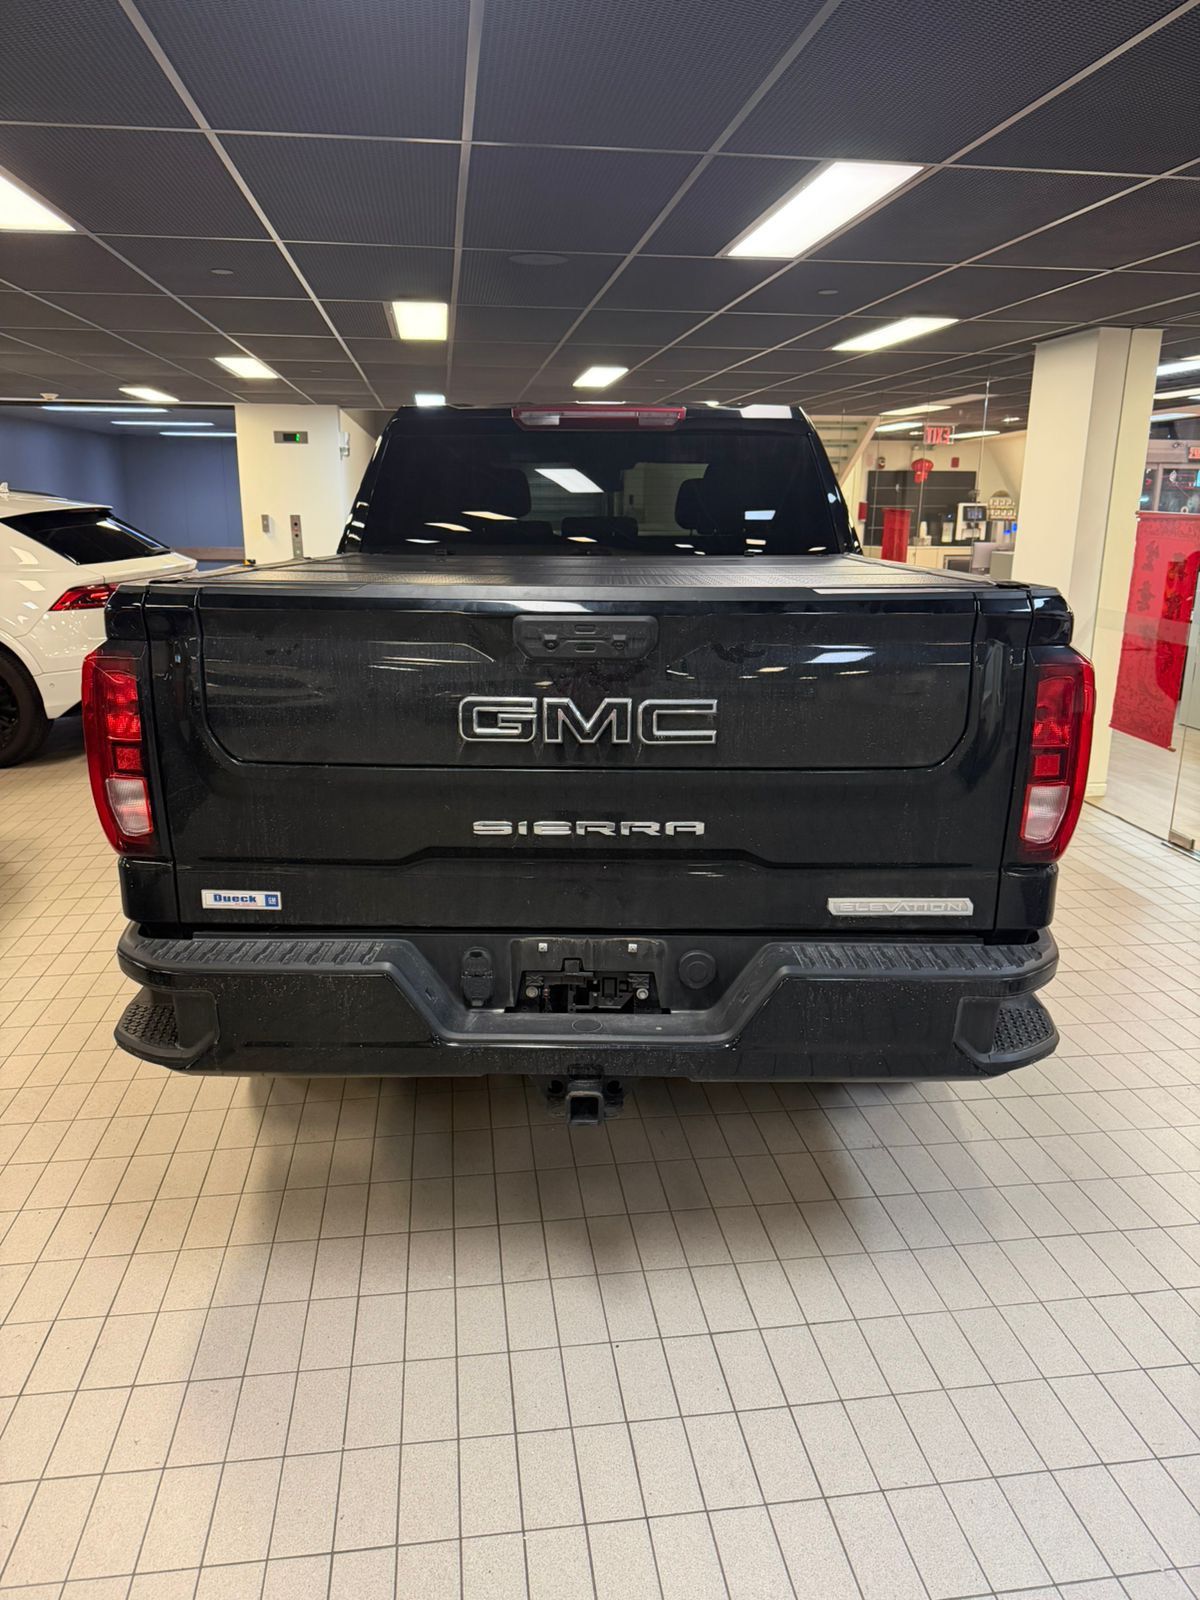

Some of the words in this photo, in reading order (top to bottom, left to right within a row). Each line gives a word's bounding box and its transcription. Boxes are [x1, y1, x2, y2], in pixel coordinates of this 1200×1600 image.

[458, 696, 718, 744] GMC
[472, 820, 705, 836] SIERRA
[213, 894, 257, 903] Dueck
[839, 901, 962, 913] ELEVATION
